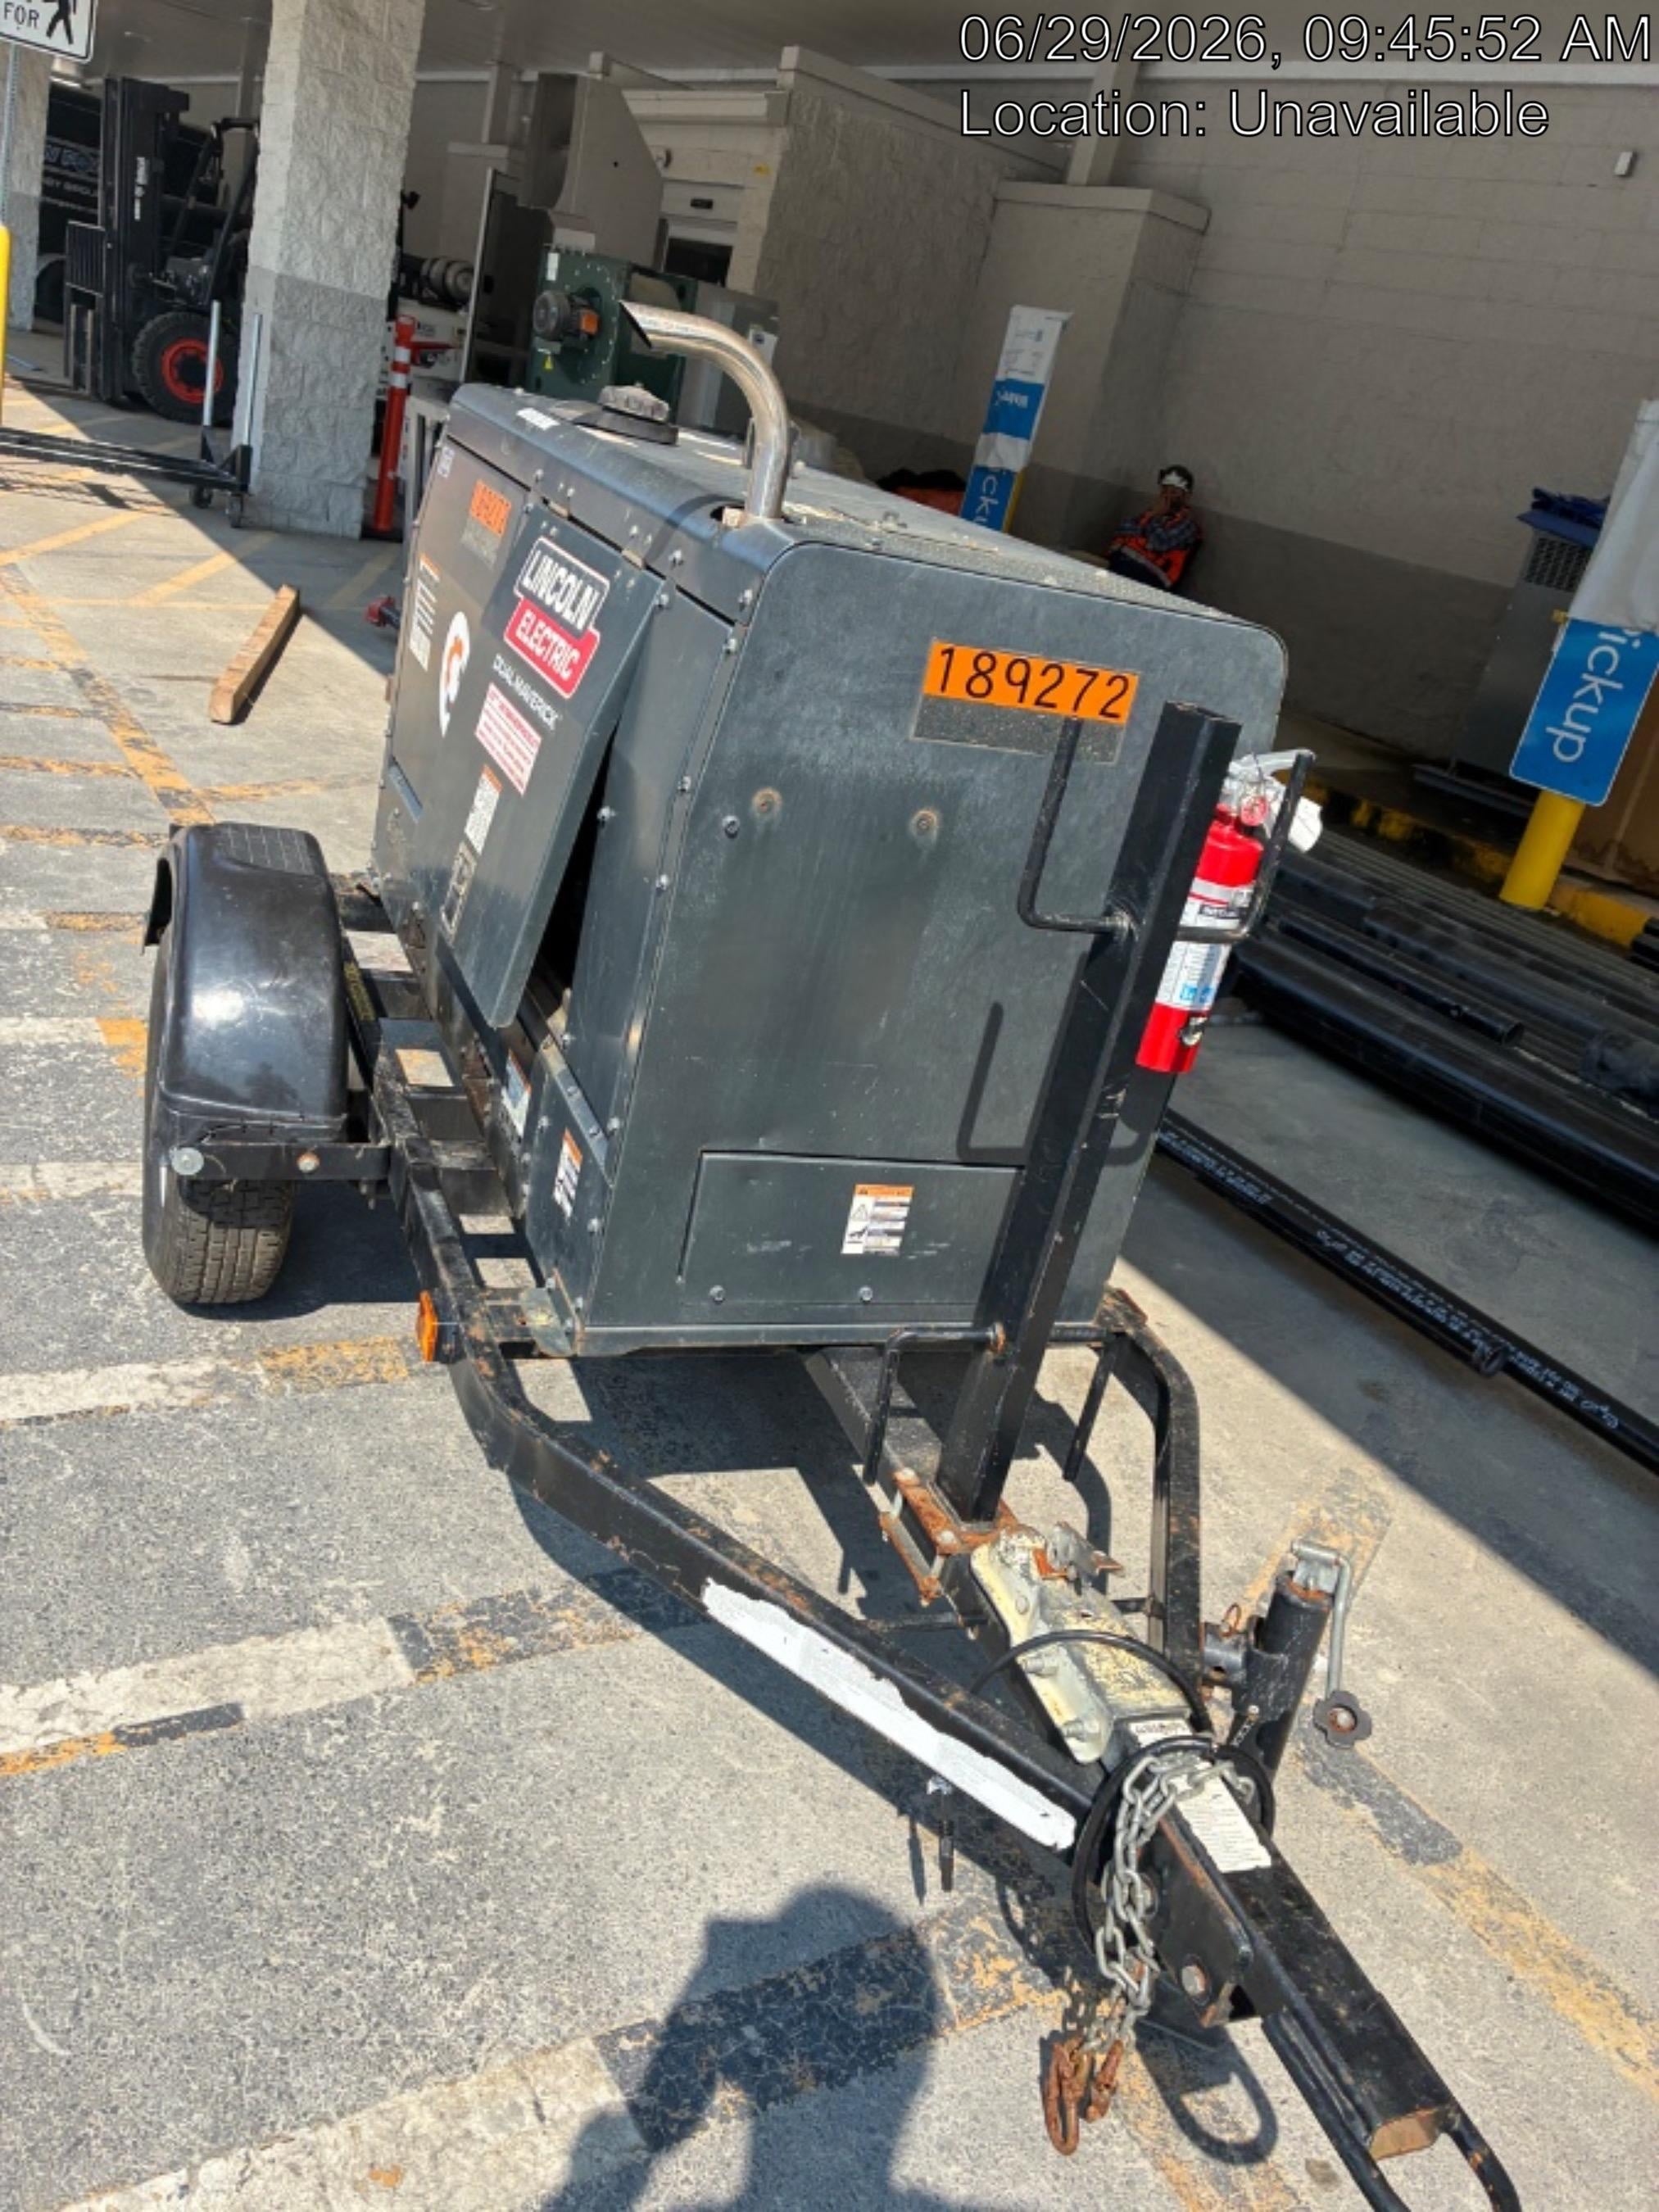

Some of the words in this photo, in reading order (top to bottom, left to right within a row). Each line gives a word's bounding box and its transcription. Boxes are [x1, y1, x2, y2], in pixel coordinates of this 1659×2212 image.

[4, 2, 39, 29] FOR
[521, 550, 601, 630] LINCOLN
[514, 609, 581, 681] ELECTRIC
[940, 646, 1130, 718] 189272
[1545, 628, 1640, 763] ickup
